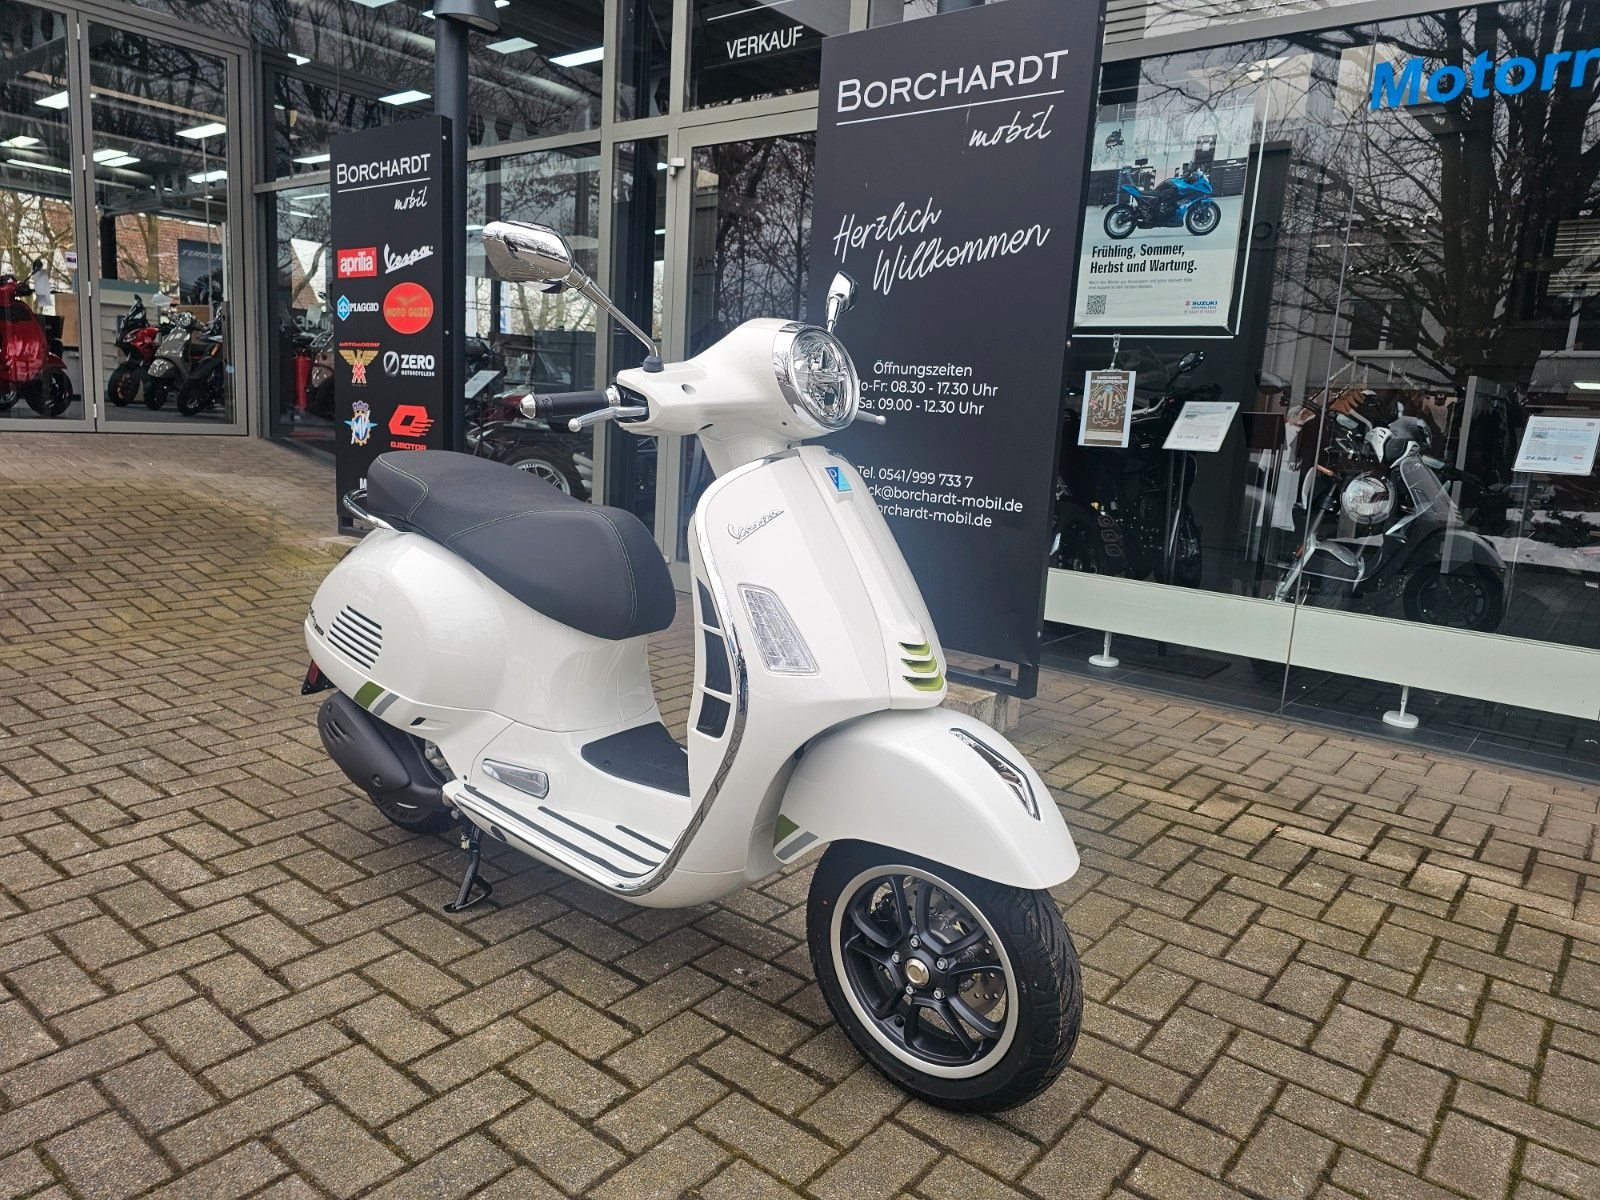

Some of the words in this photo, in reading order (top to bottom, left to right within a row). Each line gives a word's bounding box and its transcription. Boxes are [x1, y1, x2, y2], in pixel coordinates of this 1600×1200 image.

[726, 26, 804, 60] VERKAUF
[836, 49, 1069, 113] BORCHARDT
[969, 105, 1054, 148] mobil
[336, 153, 431, 185] BORCHARDT
[394, 186, 428, 211] mobil
[833, 197, 943, 263] Herzlich
[340, 251, 374, 277] aprilia
[383, 243, 434, 275] Vespa
[873, 224, 1051, 296] Willkommen
[1091, 245, 1137, 260] Frühling,
[1139, 243, 1185, 257] Sommer,
[1090, 261, 1124, 273] Herbst
[1126, 260, 1147, 273] und
[1149, 258, 1198, 274] Wartung.
[349, 302, 379, 312] PIAGGIO
[386, 307, 406, 317] MOTO
[408, 306, 430, 317] GUZZI
[400, 354, 435, 370] ZERO
[873, 360, 973, 378] Öffnungszeiten
[858, 379, 888, 392] o-Fr:
[890, 380, 926, 394] 08.30
[937, 382, 969, 395] 17.30
[972, 383, 998, 397] Uhr
[858, 396, 875, 409] Sa:
[878, 398, 912, 411] 09.00
[924, 400, 955, 413] 12.30
[958, 401, 985, 415] Uhr
[857, 465, 876, 479] Tel.
[878, 468, 936, 484] 0541/999
[939, 474, 961, 488] 733
[964, 475, 974, 489] 7
[868, 484, 1023, 513] ck@borchardt-mobil.de
[877, 503, 993, 528] orchardt-mobil.de
